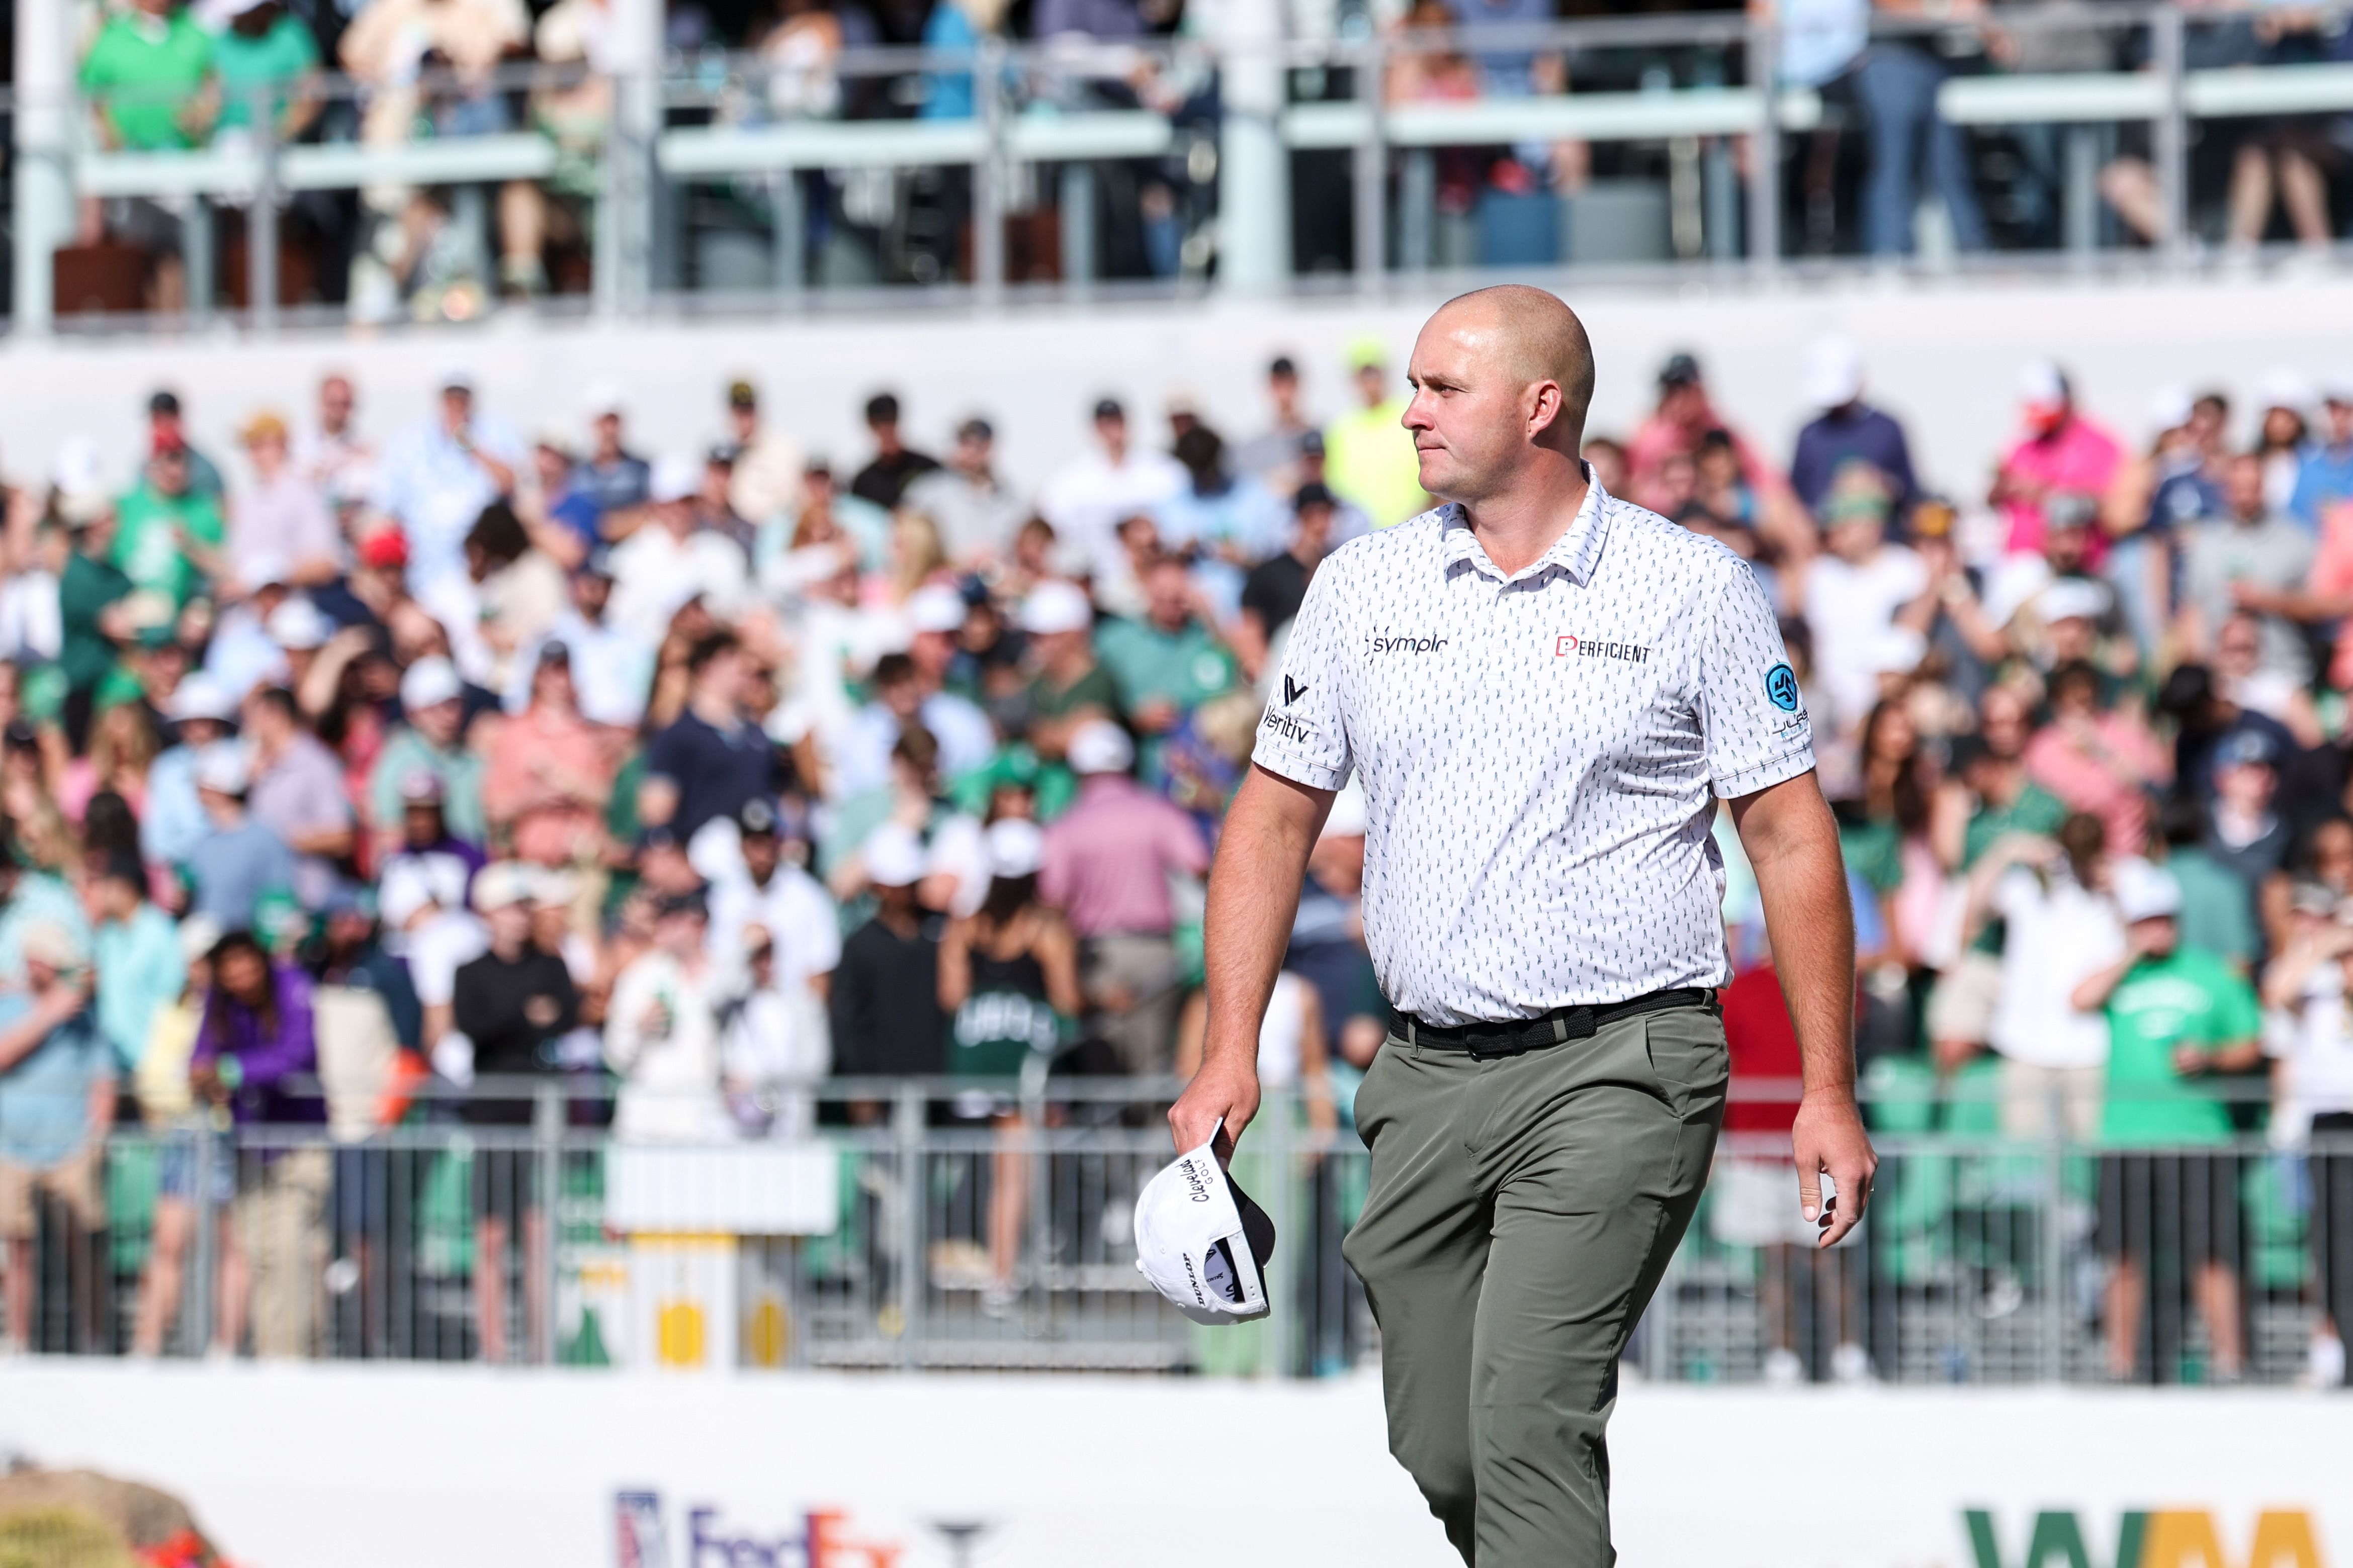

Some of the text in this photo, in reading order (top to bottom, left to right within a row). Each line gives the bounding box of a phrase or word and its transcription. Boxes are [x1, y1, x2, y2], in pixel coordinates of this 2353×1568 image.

[1374, 634, 1448, 656] symplr
[1555, 635, 1651, 664] PERFICIENT
[1263, 705, 1310, 743] Veritiv
[1175, 1159, 1209, 1202] Cleveland
[1195, 1159, 1213, 1184] GOLF
[1183, 1253, 1205, 1307] DUNLOP
